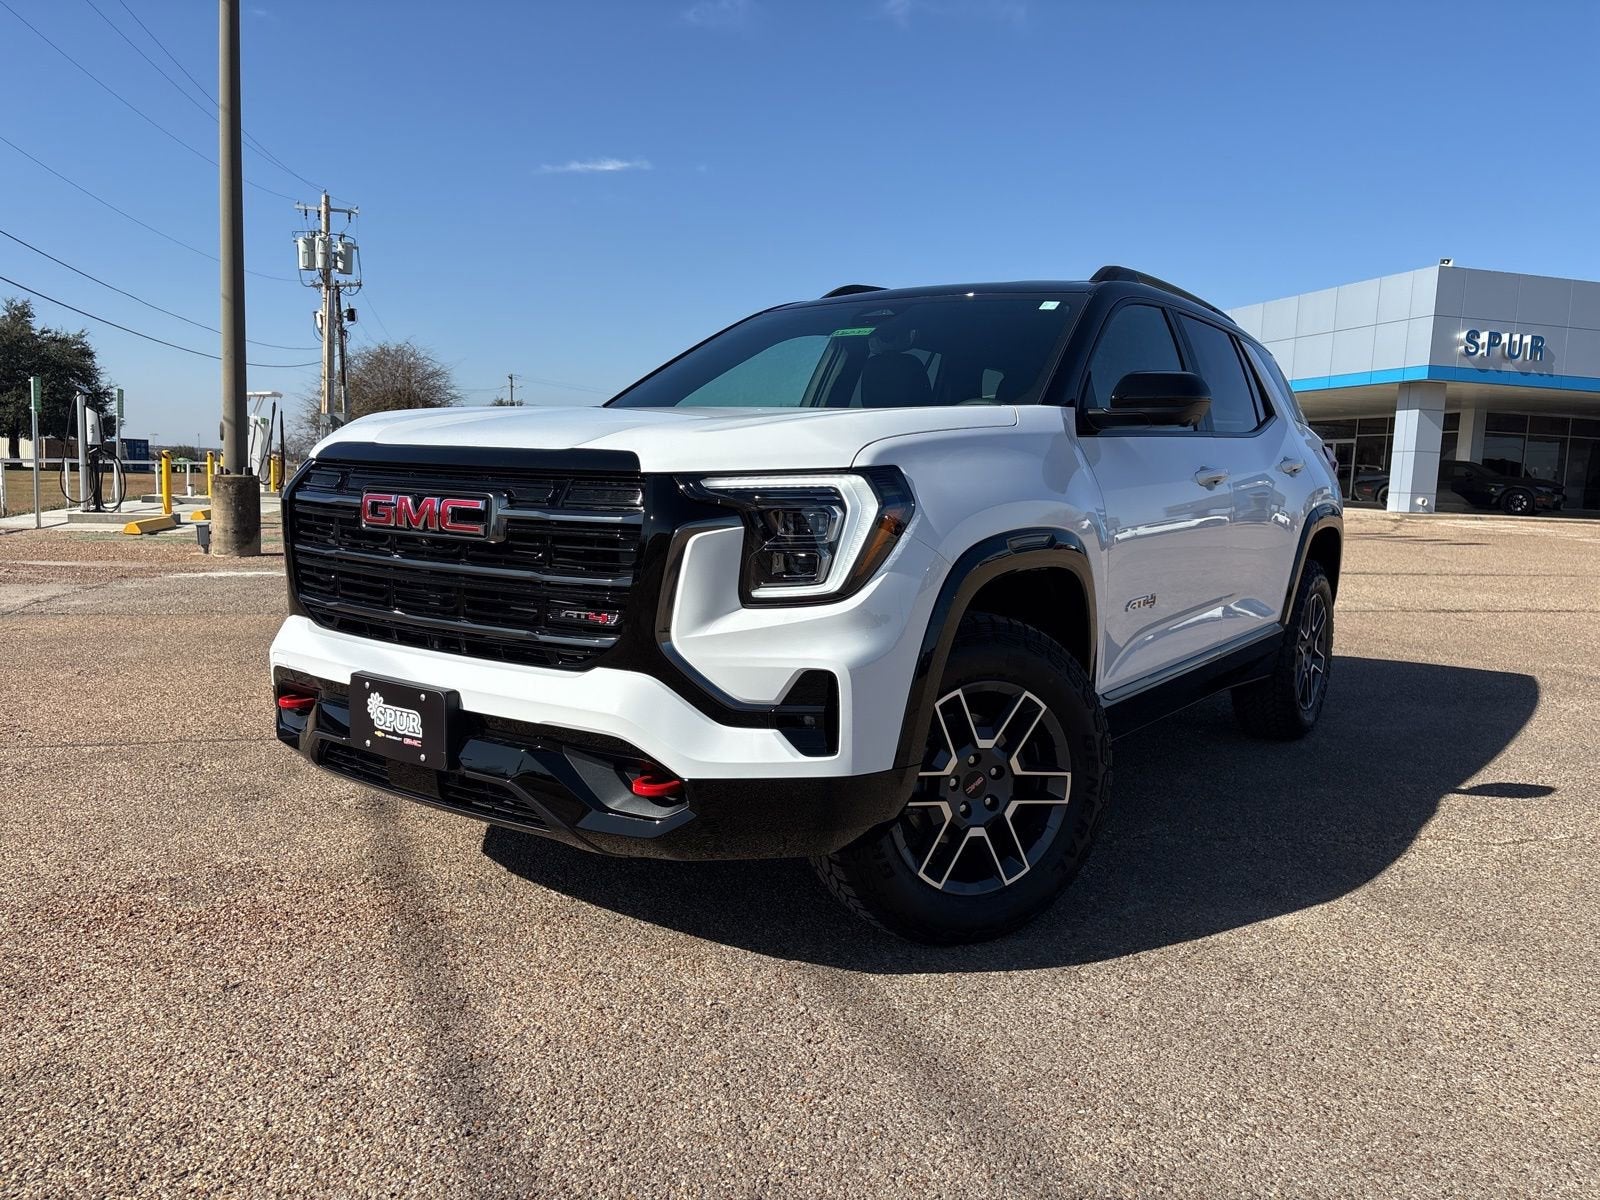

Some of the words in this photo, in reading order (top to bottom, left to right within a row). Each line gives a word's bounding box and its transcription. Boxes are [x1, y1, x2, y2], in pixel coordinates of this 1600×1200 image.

[1461, 329, 1545, 361] SPUR
[362, 493, 486, 536] GMC
[375, 705, 422, 737] SPUR
